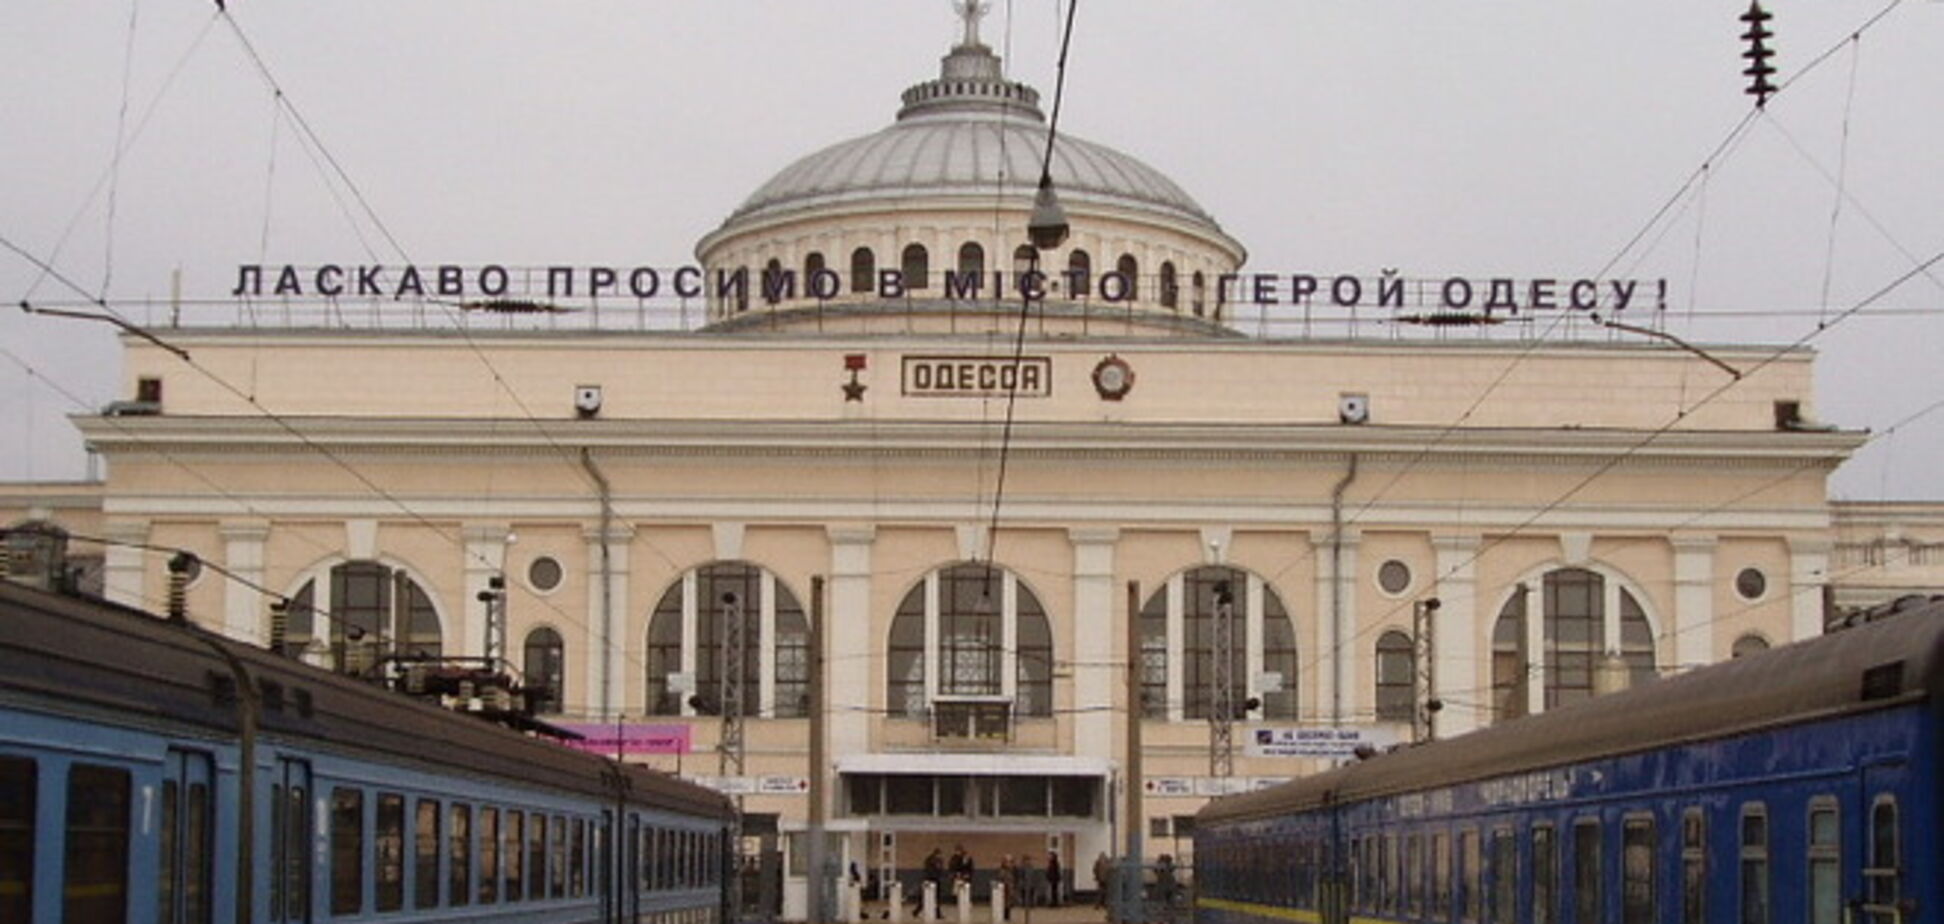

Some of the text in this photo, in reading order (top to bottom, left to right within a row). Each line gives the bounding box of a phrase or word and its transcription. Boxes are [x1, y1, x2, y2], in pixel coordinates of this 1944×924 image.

[232, 263, 510, 298] ЛАСКАВО
[546, 265, 840, 300] ПРОСИМО
[879, 268, 904, 298] В
[1218, 270, 1406, 308] ГЕРОЙ
